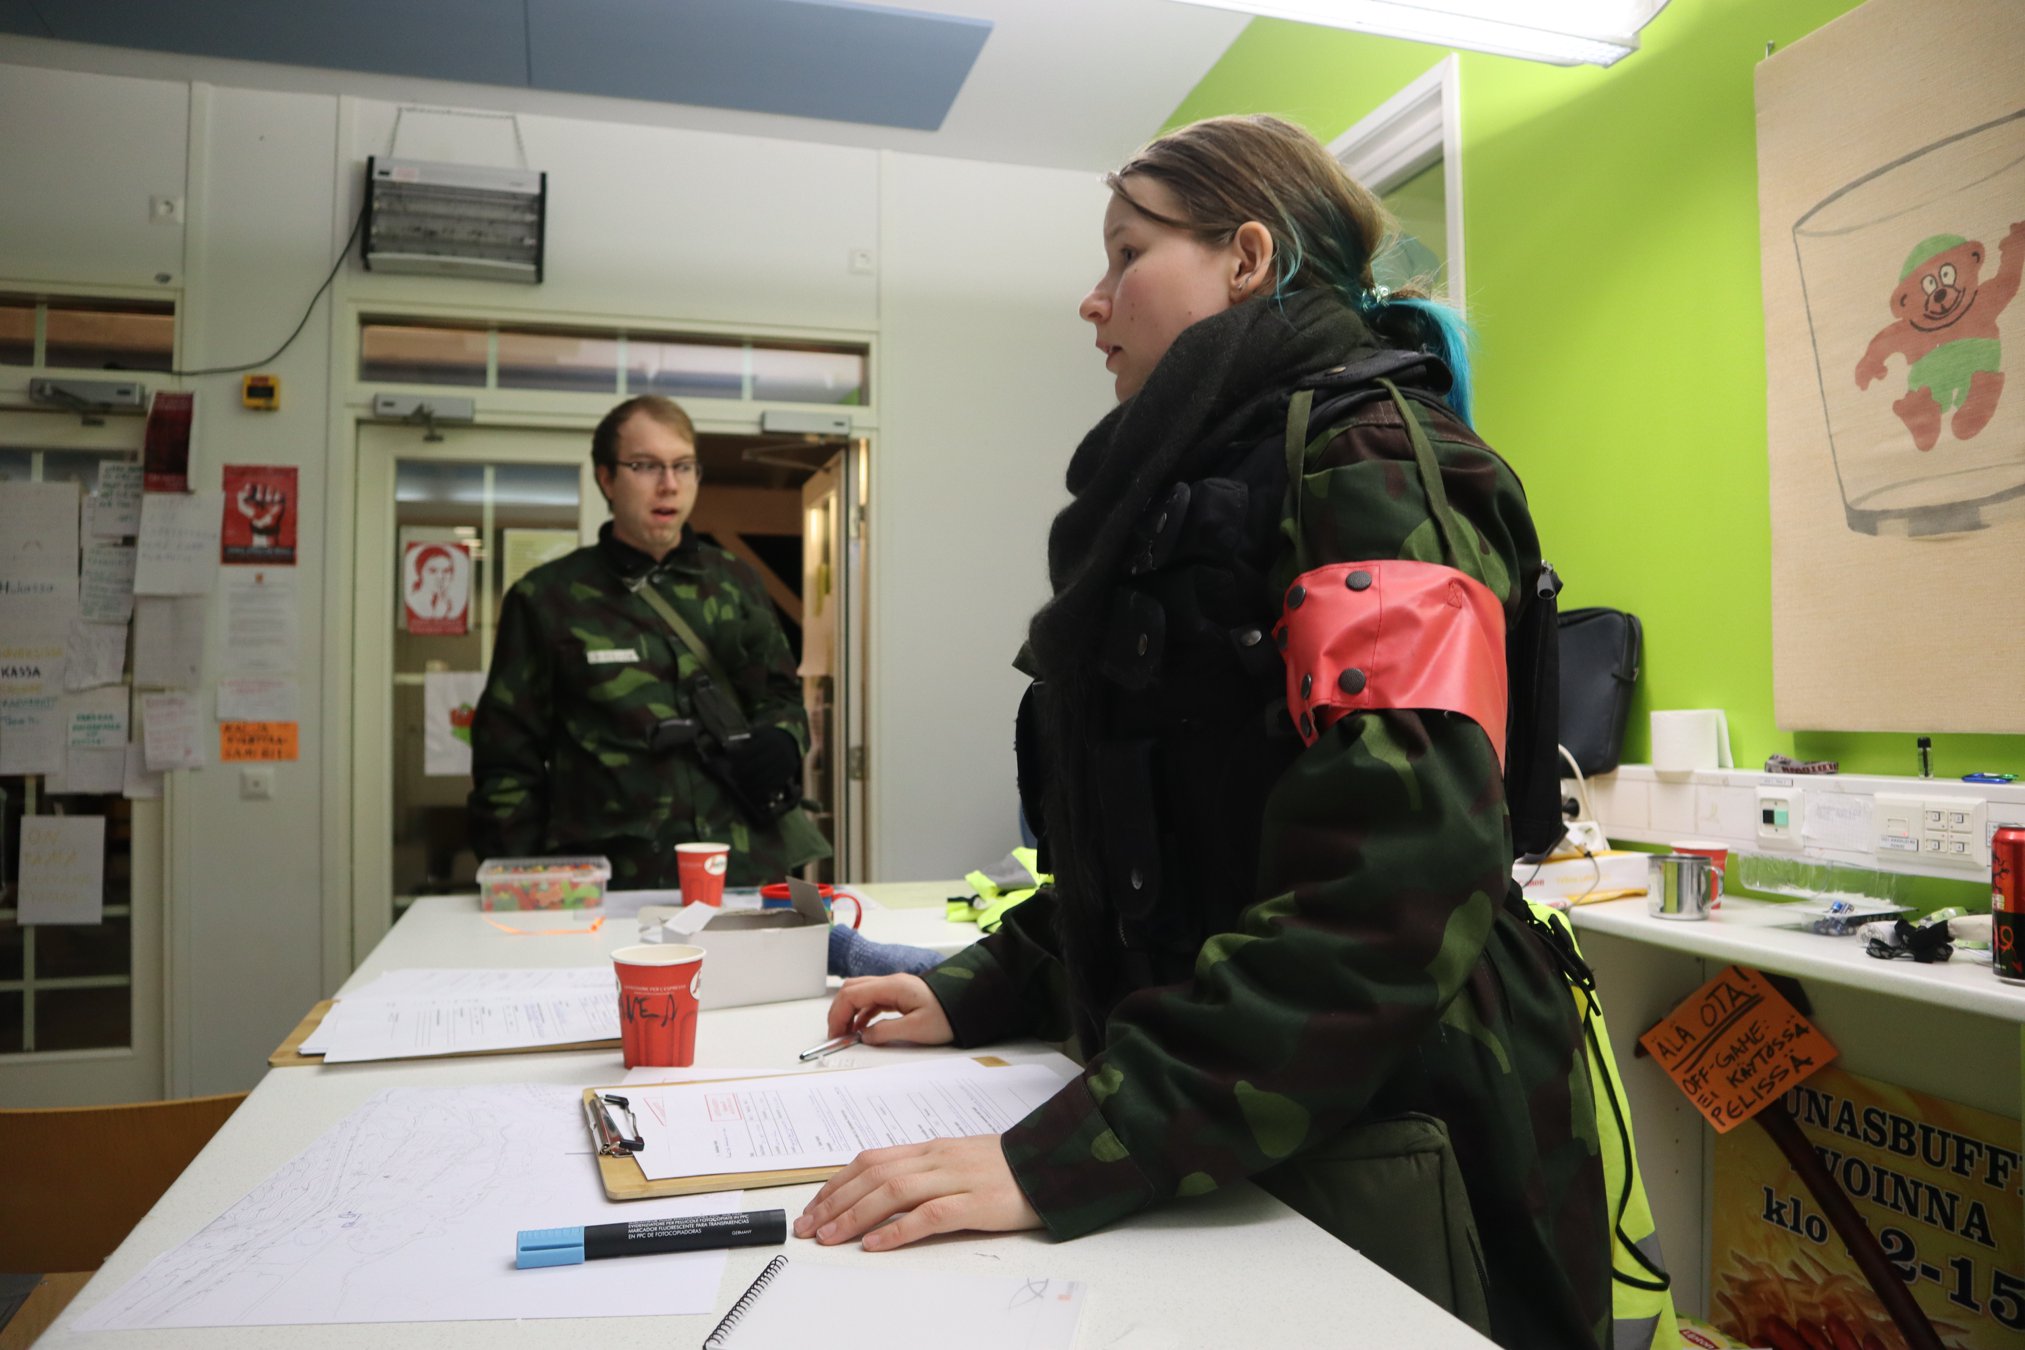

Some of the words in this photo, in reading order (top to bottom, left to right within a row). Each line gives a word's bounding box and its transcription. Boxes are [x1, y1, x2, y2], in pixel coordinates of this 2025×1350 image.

[1651, 1020, 1697, 1060] ÄLÄ
[1700, 964, 1761, 1028] OTA!
[1697, 1091, 1720, 1109] EI
[1711, 1049, 1814, 1127] PELISSÄ
[1784, 1086, 2025, 1195] UNASBUFF
[628, 1226, 658, 1234] MARCADOR
[658, 1223, 695, 1231] FLUORESCENTE
[708, 1218, 750, 1227] TRANSPARENCIAS
[655, 1228, 702, 1237] FOTOCOPIADORAS
[1791, 1145, 1997, 1248] VOINNA
[1762, 1186, 1829, 1245] klo
[1847, 1215, 2025, 1333] 2-15
